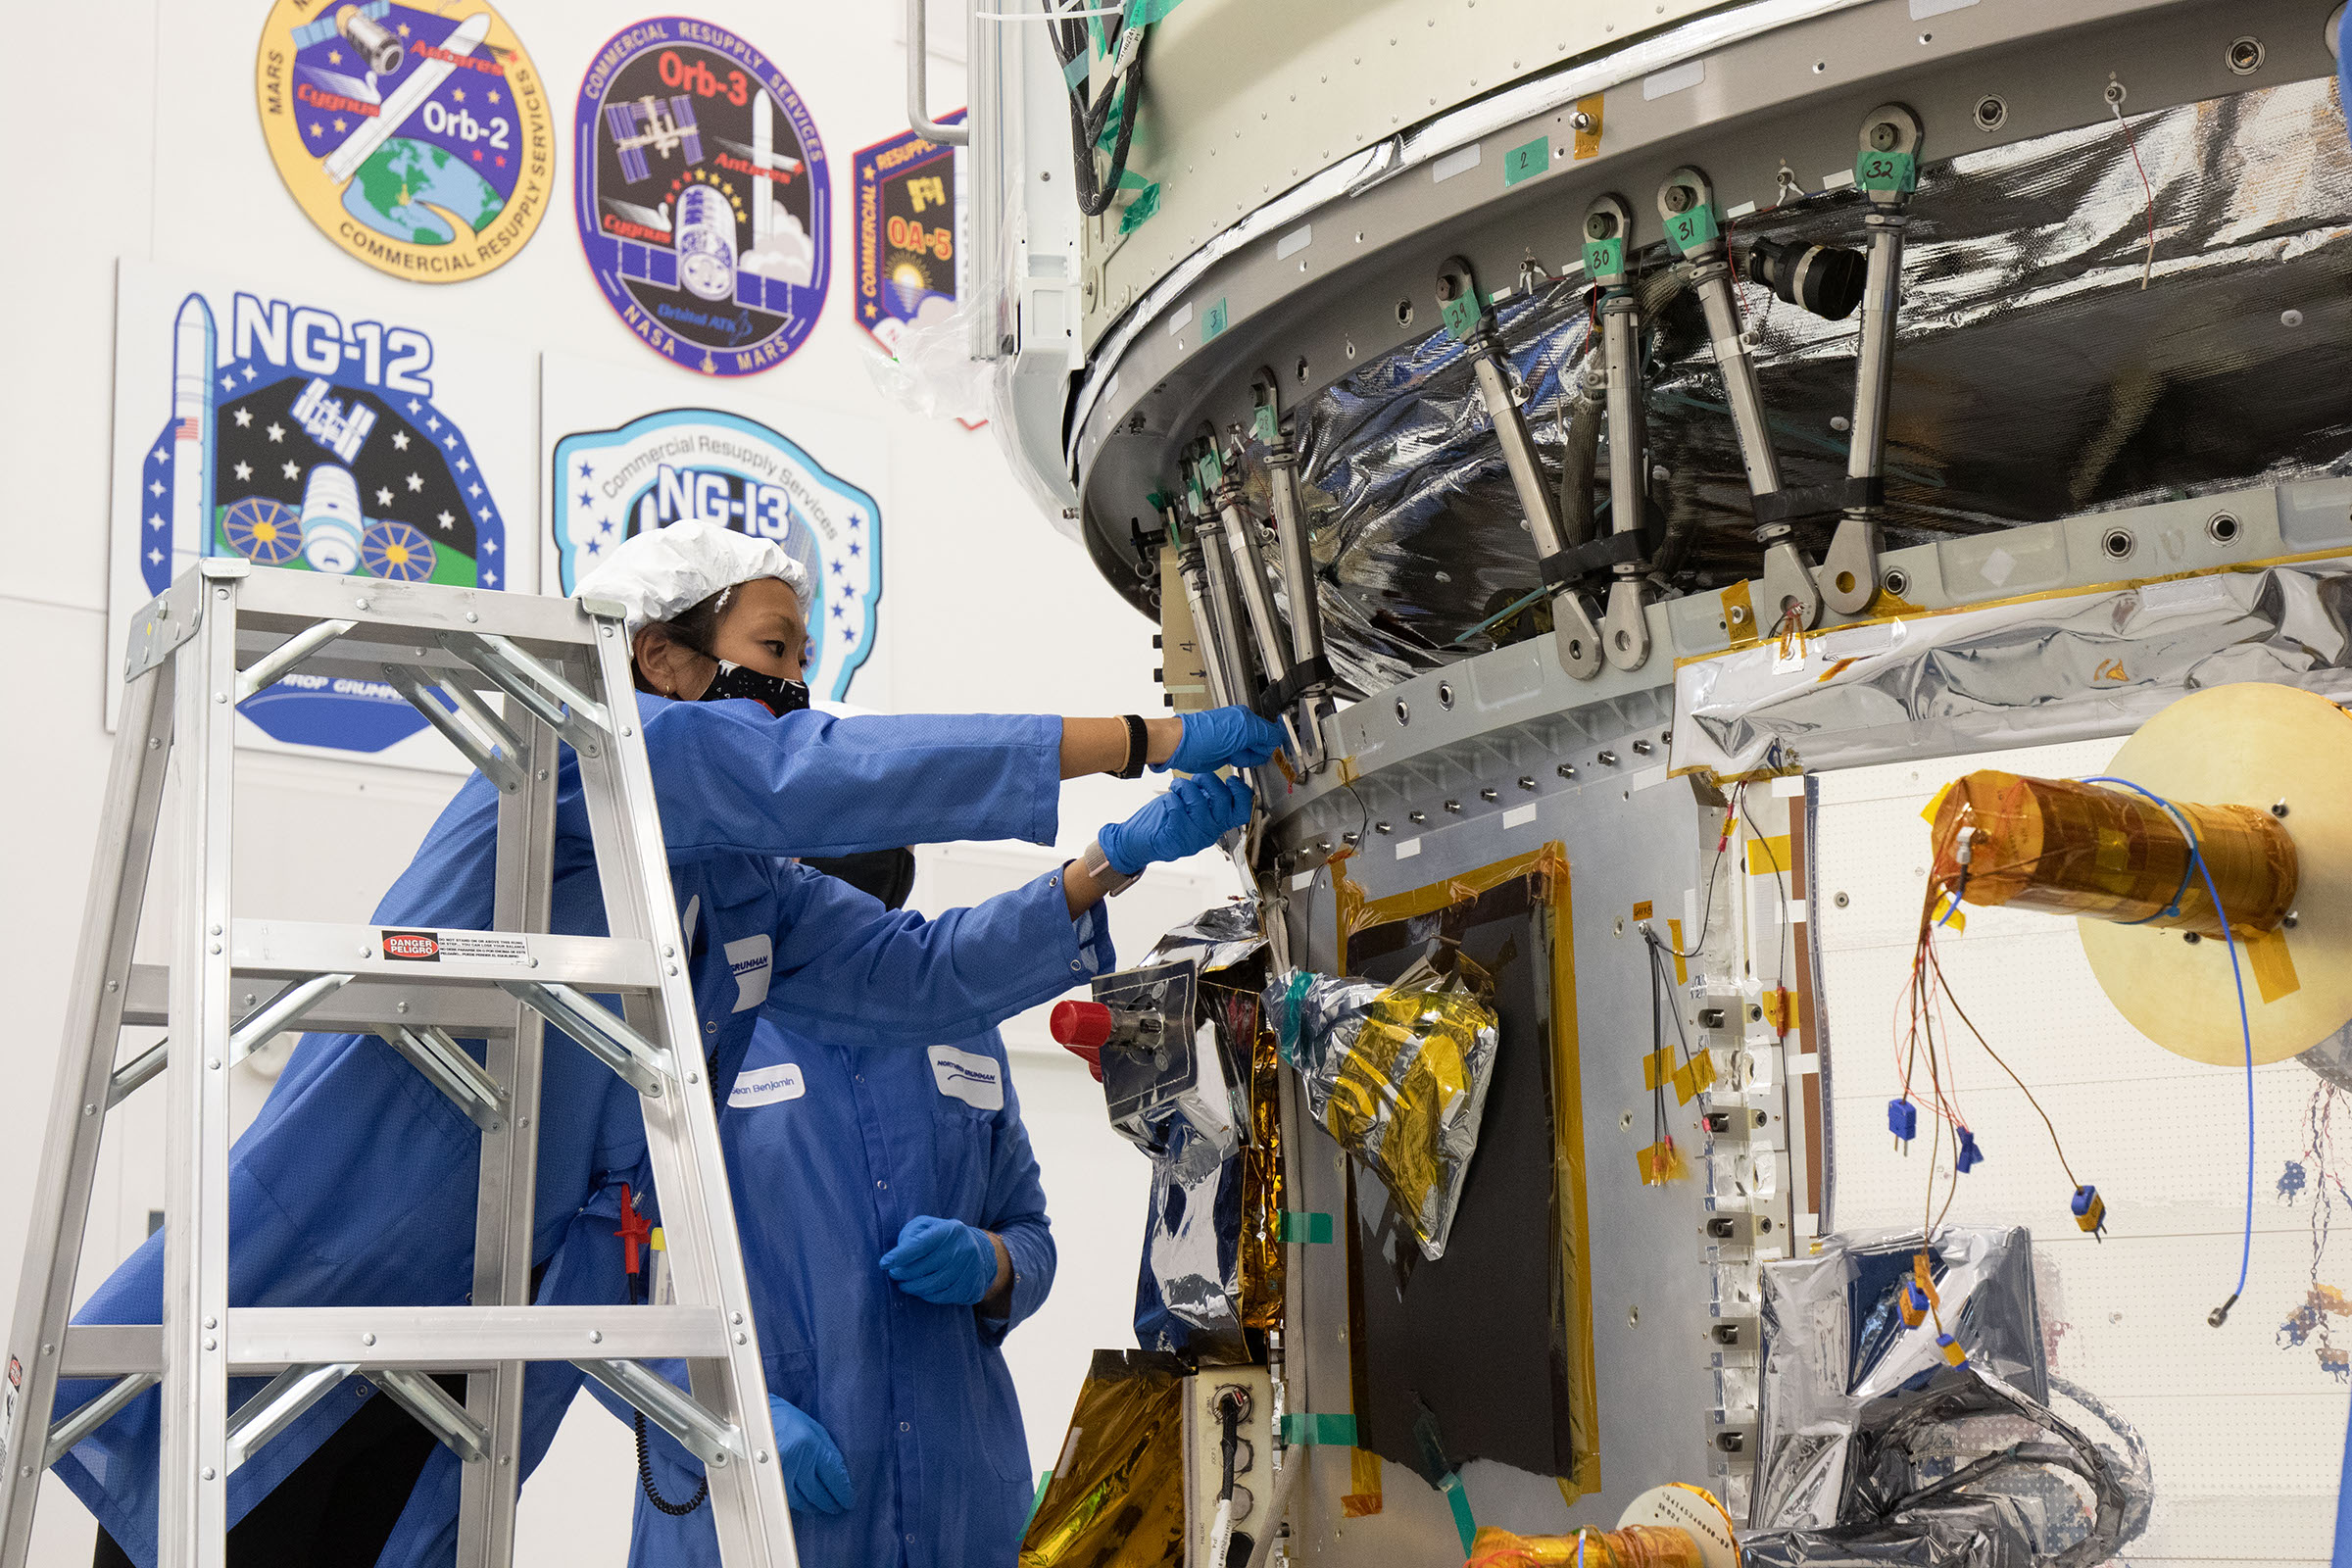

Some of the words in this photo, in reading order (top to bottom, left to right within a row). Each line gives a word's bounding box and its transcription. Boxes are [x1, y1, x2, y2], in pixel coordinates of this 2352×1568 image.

[269, 50, 284, 115] MARS
[585, 23, 668, 99] COMMERCIAL
[678, 22, 763, 70] RESUPPLY
[769, 73, 823, 163] SERVICES
[659, 50, 749, 107] Orb-3
[422, 100, 510, 150] Orb-2
[339, 221, 475, 273] COMMERCIAL
[477, 182, 542, 263] RESUPPLY
[515, 68, 547, 177] SERVICES
[1520, 151, 1529, 170] 2
[1865, 160, 1893, 180] 32
[861, 185, 877, 298] COMMERCIAL
[887, 216, 953, 261] OA-5
[1679, 220, 1695, 240] 31
[1592, 249, 1610, 270] 30
[623, 305, 676, 357] NASA
[1210, 309, 1220, 328] 3
[1453, 301, 1467, 329] 29
[234, 292, 432, 397] NG-12
[736, 335, 790, 371] MARS
[602, 437, 695, 500] Commercial
[699, 435, 779, 478] Resupply
[779, 468, 839, 542] Services
[658, 464, 790, 541] NG-13
[389, 938, 433, 949] DANGER
[390, 946, 434, 956] PELIGRO
[754, 1077, 795, 1093] Benjamin
